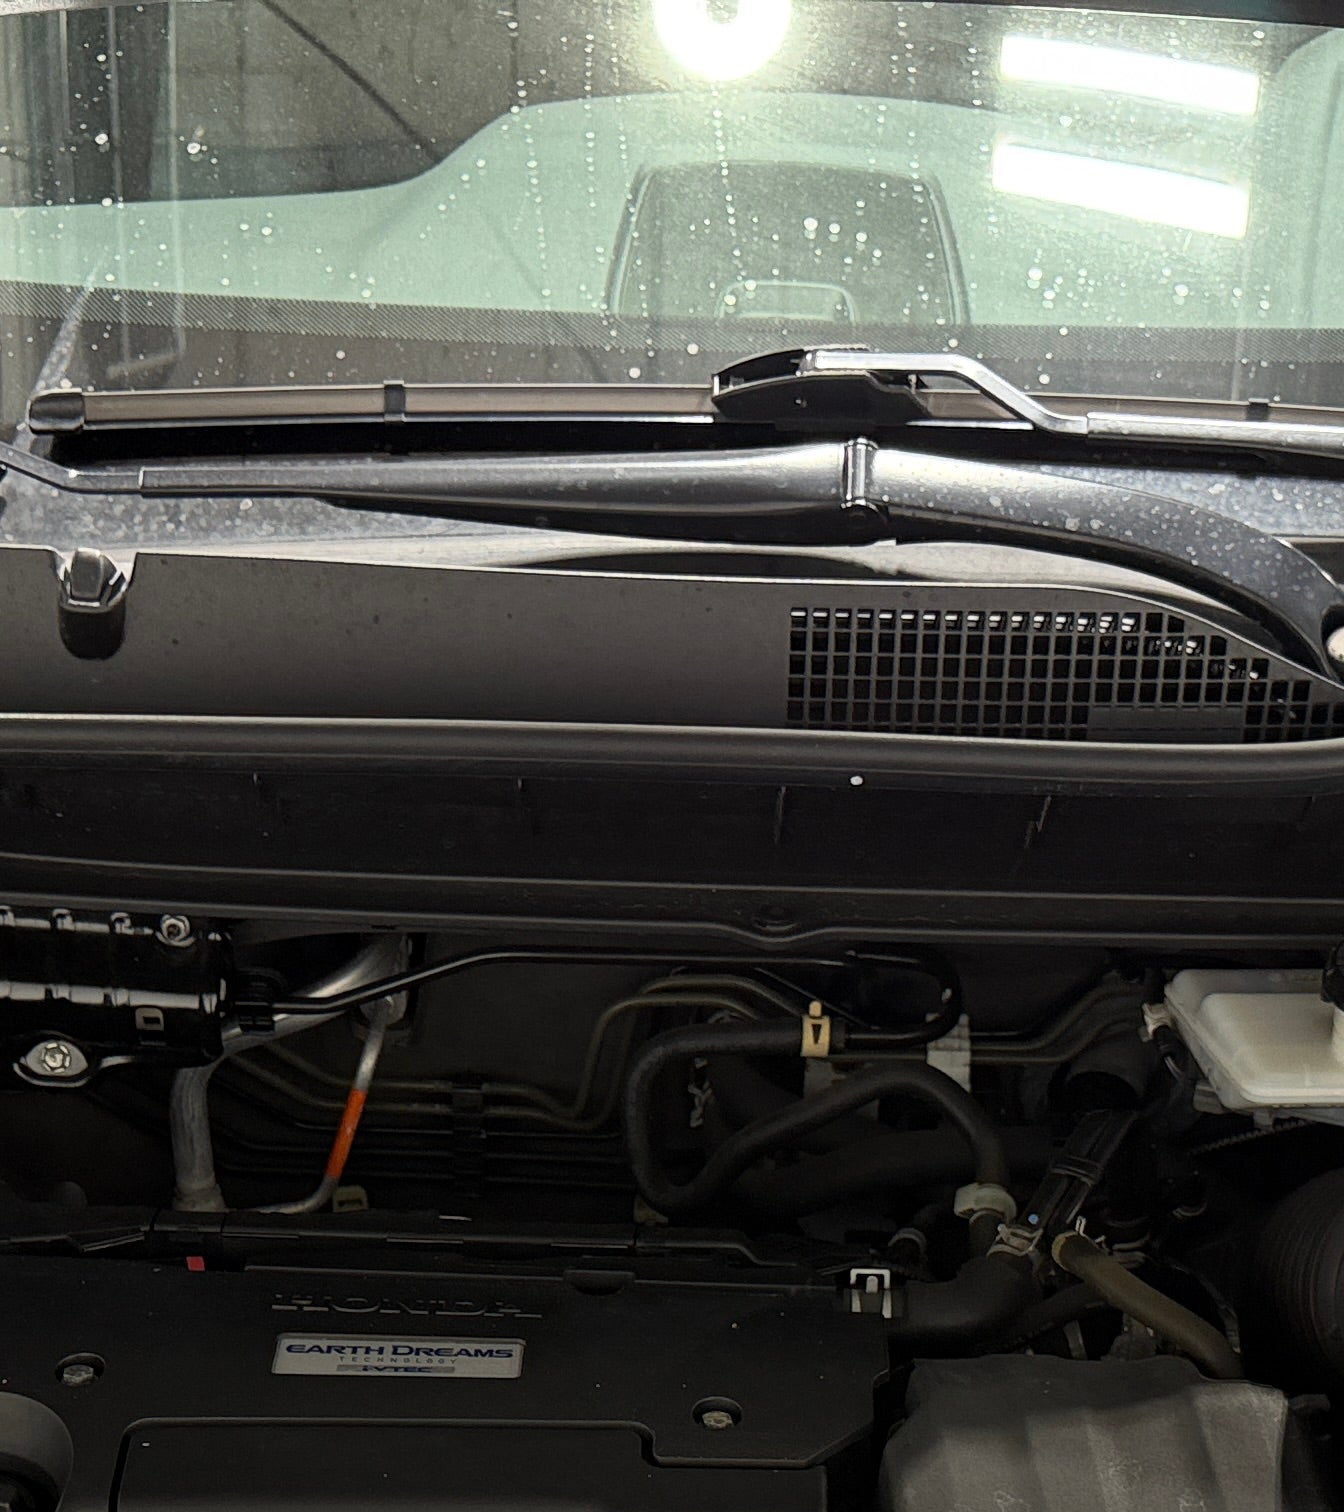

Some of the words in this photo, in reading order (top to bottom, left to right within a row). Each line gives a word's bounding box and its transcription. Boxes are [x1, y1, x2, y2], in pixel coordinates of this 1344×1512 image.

[271, 1293, 543, 1319] HONDA
[286, 1344, 384, 1355] EARTH
[392, 1345, 513, 1358] DREAMS
[338, 1356, 458, 1364] TECHNOLOGY
